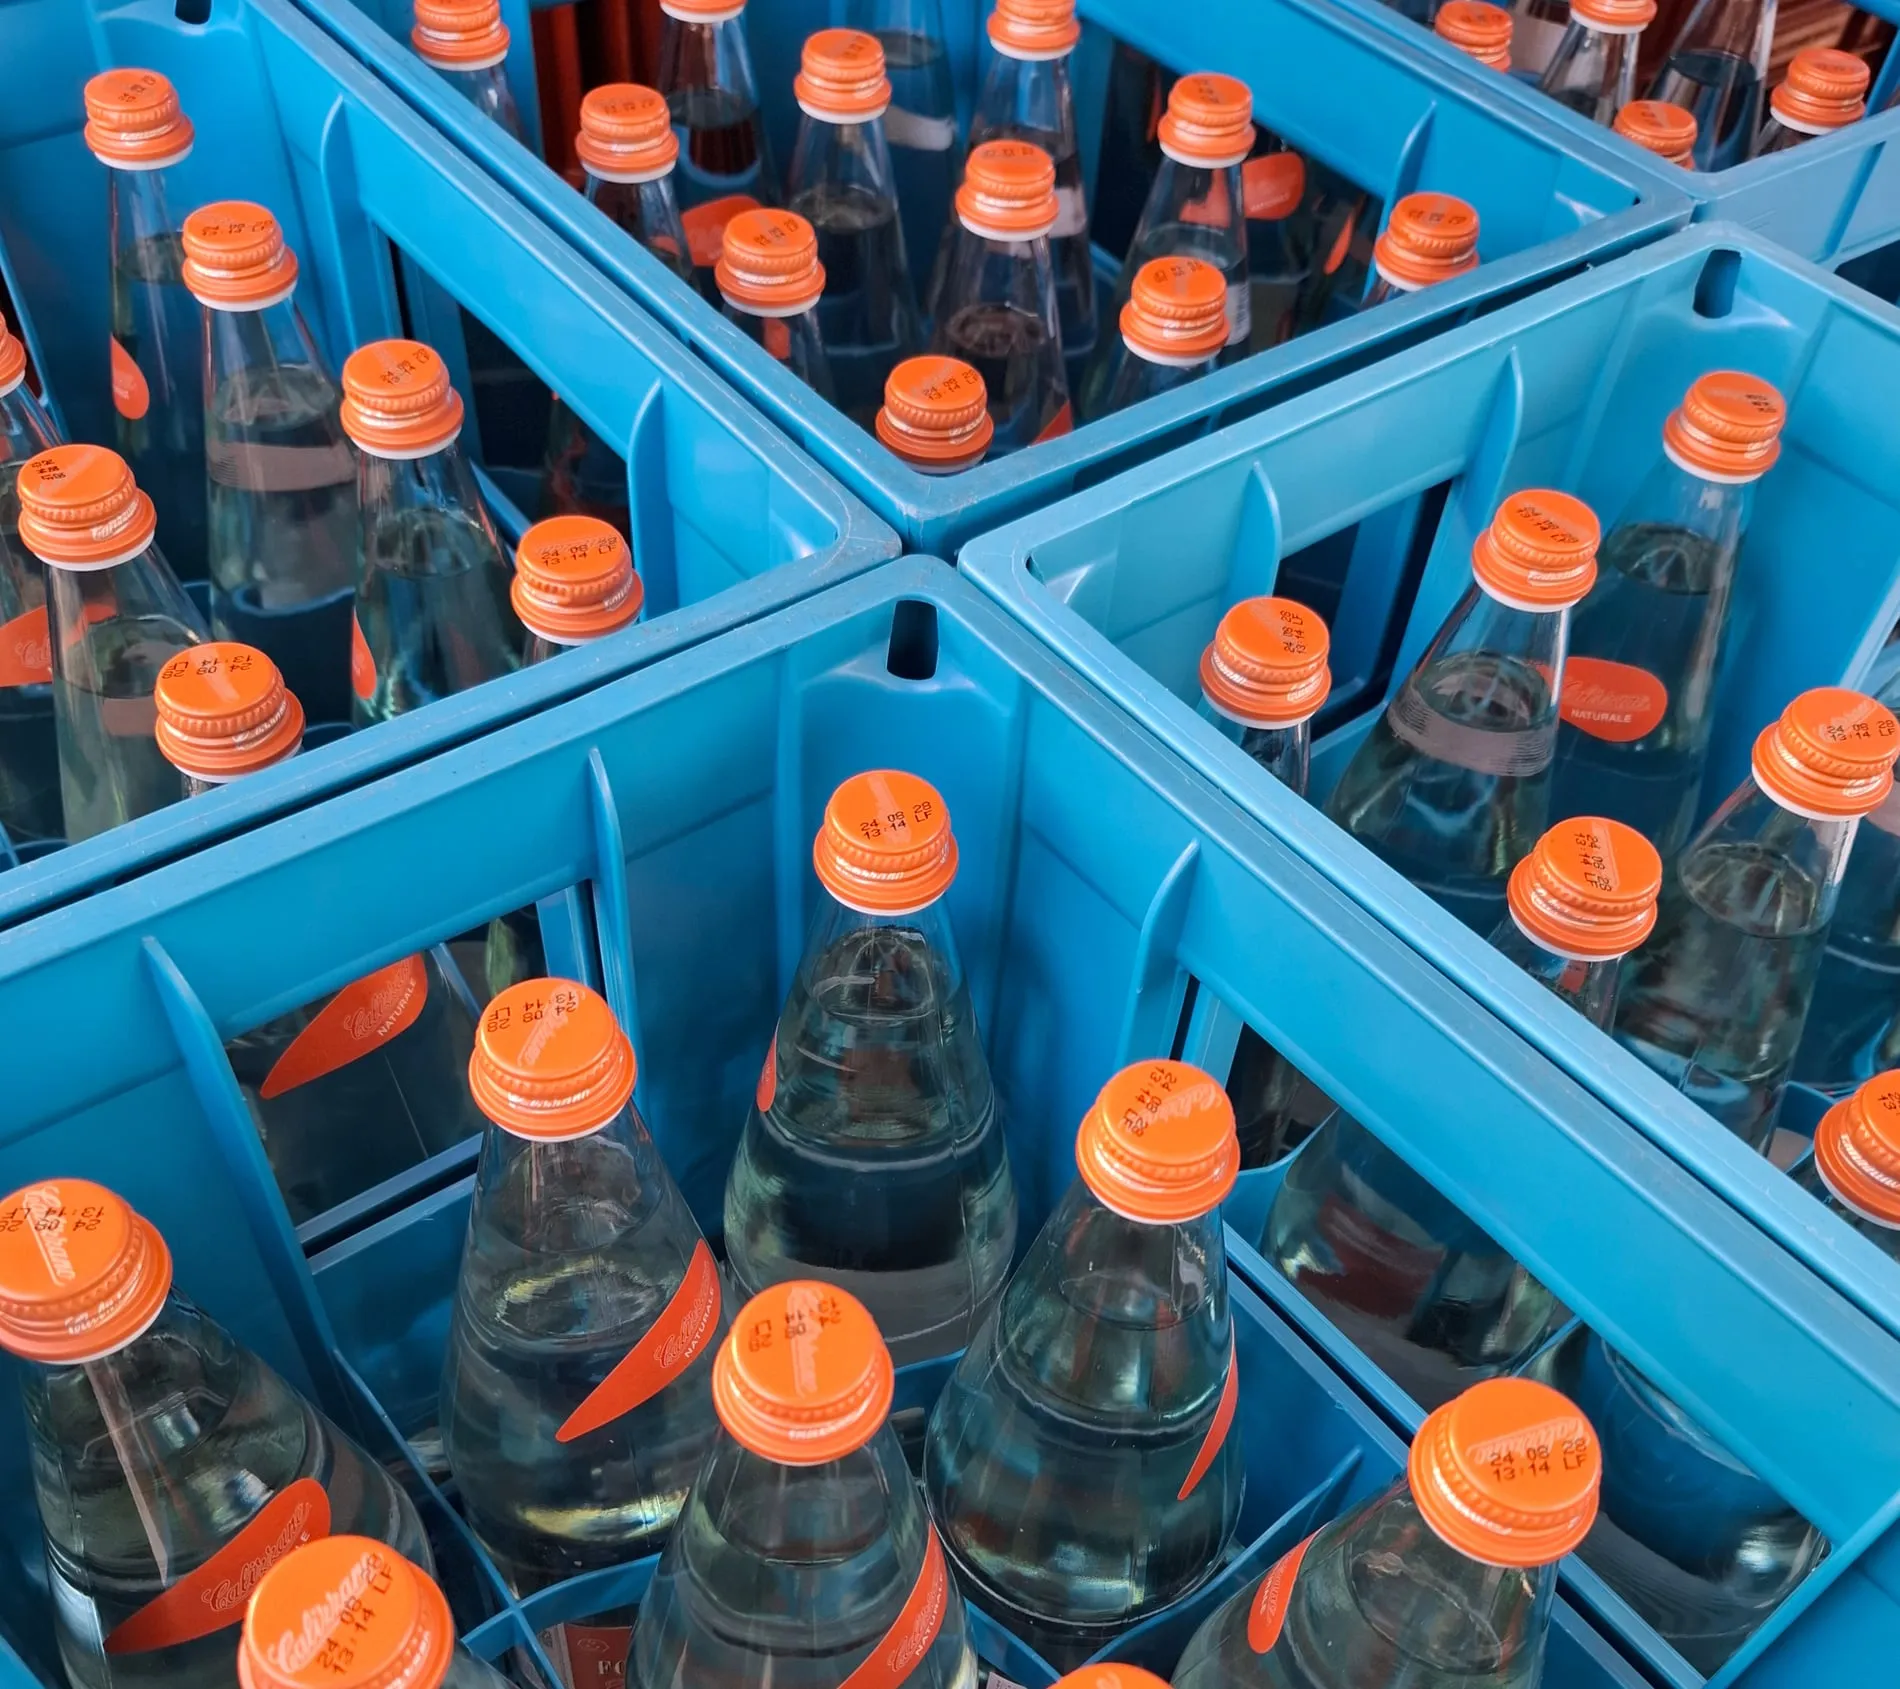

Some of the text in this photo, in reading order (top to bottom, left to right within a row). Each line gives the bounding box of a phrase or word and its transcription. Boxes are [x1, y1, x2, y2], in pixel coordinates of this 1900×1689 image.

[541, 550, 560, 560] 24
[1570, 708, 1633, 723] NATURALE
[1826, 725, 1845, 735] 24
[1877, 719, 1895, 730] 28
[1878, 728, 1896, 738] LF
[859, 800, 933, 832] 24 08 28
[914, 809, 933, 823] LF
[1586, 833, 1613, 893] 24 08 28
[1583, 871, 1599, 889] LF
[376, 979, 418, 1037] NATURALE
[486, 1001, 577, 1033] 24 08 28
[487, 1006, 511, 1021] LF
[1131, 1071, 1178, 1138] 24 08 28
[1123, 1107, 1138, 1128] LF
[2, 1206, 32, 1220] LF
[34, 1218, 61, 1232] 08
[72, 1218, 102, 1232] 24
[683, 1287, 715, 1358] NATURALE
[1489, 1437, 1588, 1467] 24 08 28
[1562, 1454, 1588, 1471] LF
[372, 1564, 394, 1595] LF
[316, 1552, 383, 1670] 24 08 28
